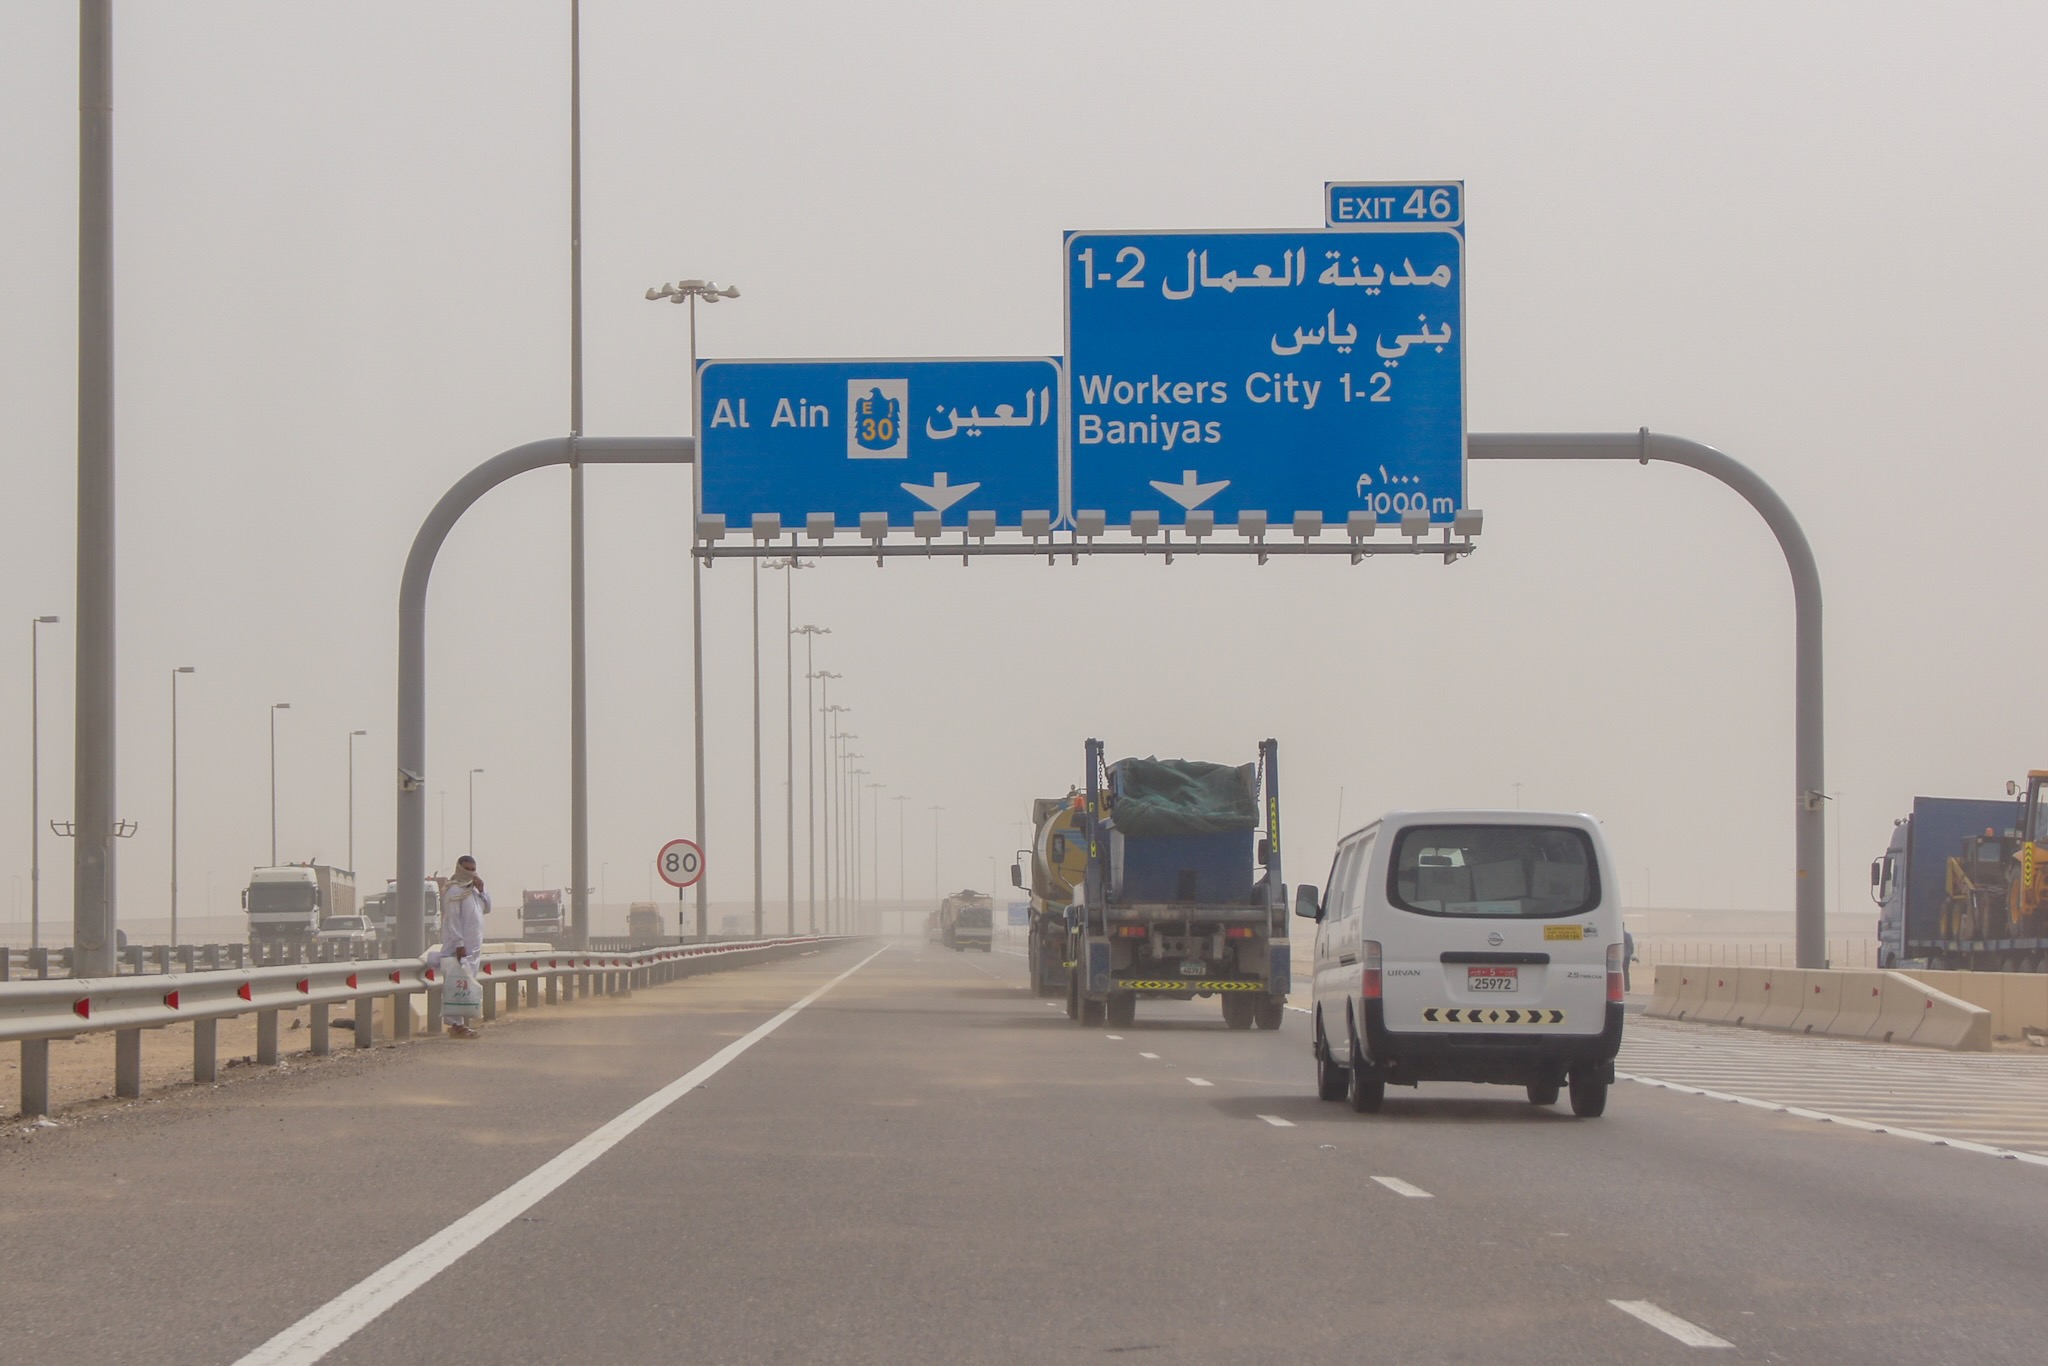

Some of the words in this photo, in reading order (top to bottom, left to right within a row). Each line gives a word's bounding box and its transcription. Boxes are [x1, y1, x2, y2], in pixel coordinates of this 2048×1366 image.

[1338, 197, 1396, 220] EXIT
[1402, 188, 1451, 219] 46
[1077, 246, 1146, 289] 1-2
[1161, 246, 1306, 301] العمال
[1318, 250, 1452, 296] مدينة
[1271, 308, 1358, 356] ياس
[1375, 313, 1452, 368] بني
[1079, 374, 1228, 405] Workers
[1245, 371, 1322, 410] City
[1339, 371, 1392, 403] 1-2
[710, 398, 750, 429] Al
[770, 397, 829, 428] Ain
[862, 401, 873, 415] E
[925, 386, 1050, 440] العين
[862, 418, 894, 441] 30
[1079, 413, 1222, 451] Baniyas
[1364, 492, 1427, 514] 1000
[1432, 497, 1454, 514] m
[665, 852, 697, 873] 80
[1387, 969, 1421, 977] URVAN
[1474, 978, 1512, 990] 25972
[1489, 968, 1496, 976] 5
